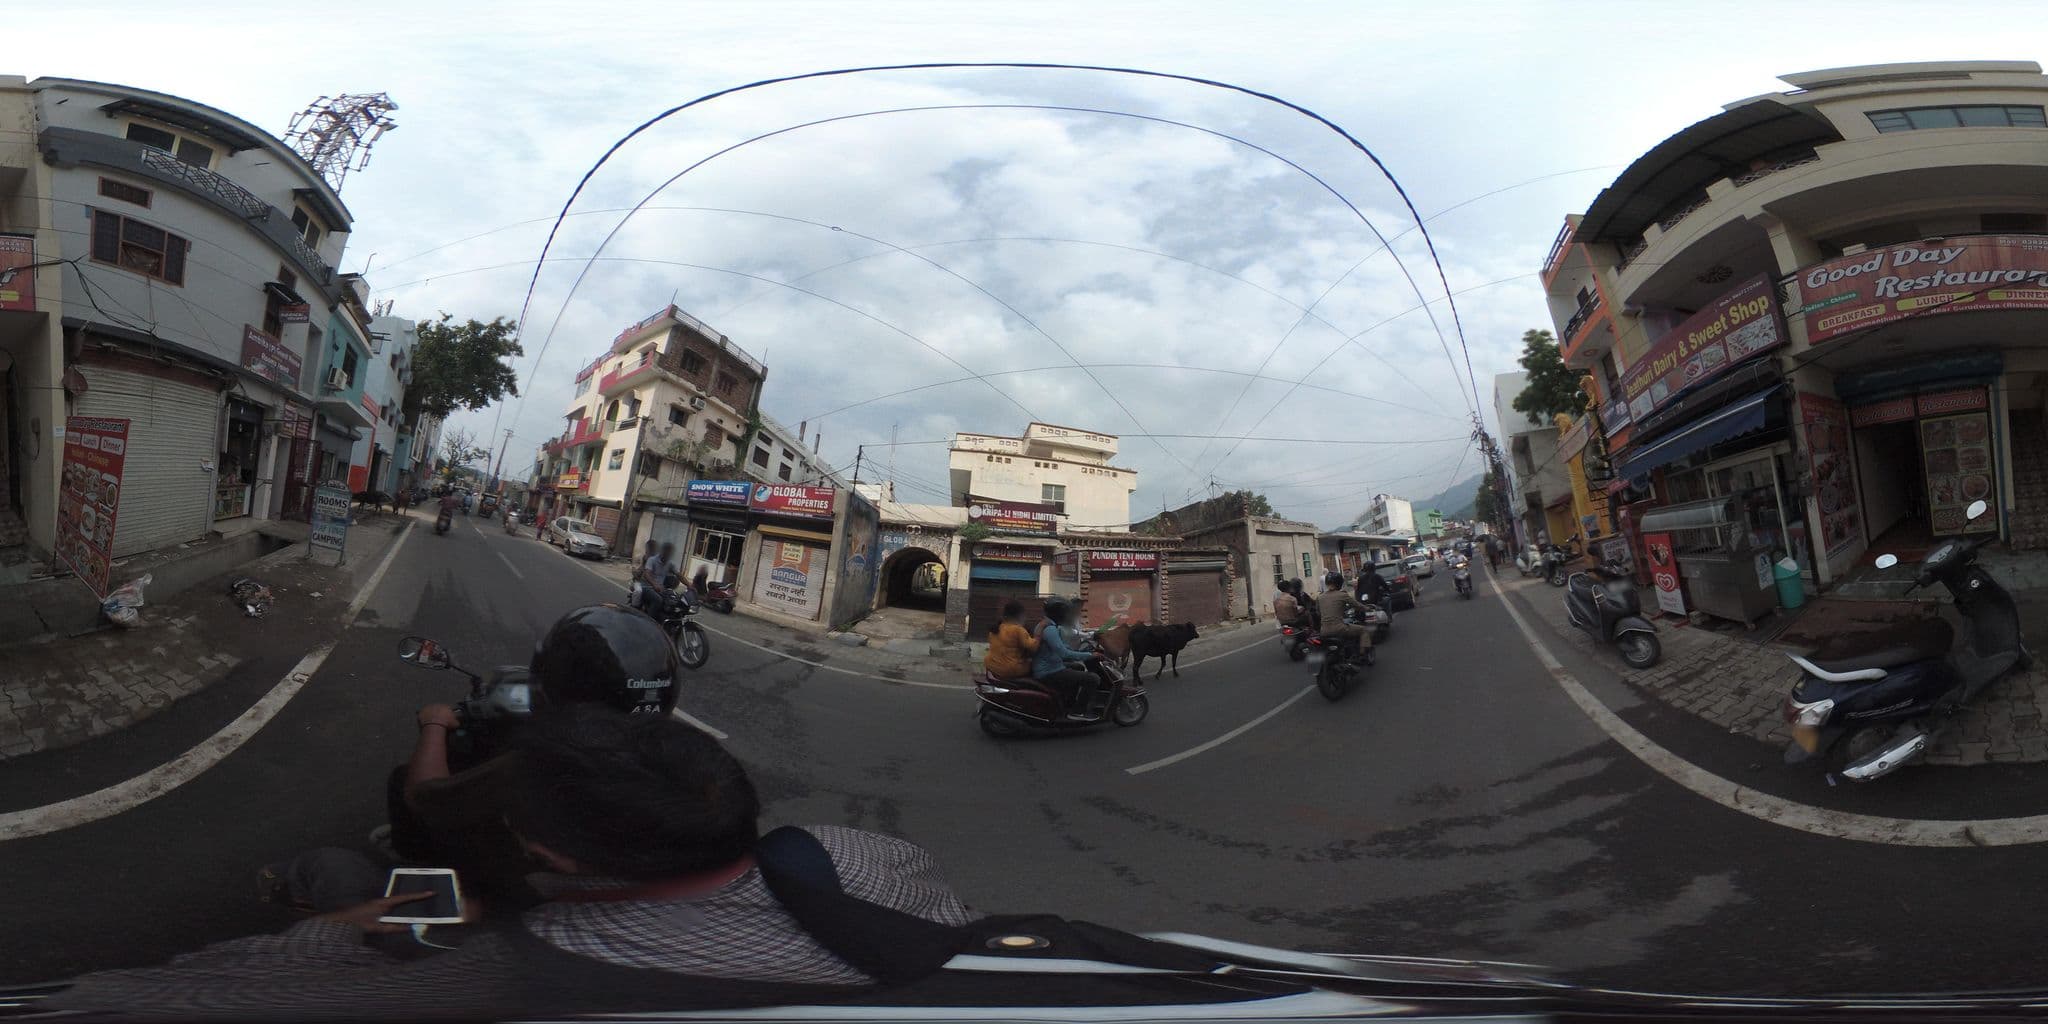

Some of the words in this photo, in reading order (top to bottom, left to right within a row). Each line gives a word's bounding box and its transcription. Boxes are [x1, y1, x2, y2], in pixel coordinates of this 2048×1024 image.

[1806, 253, 1885, 289] Good
[1892, 245, 1967, 266] Day
[1916, 295, 1954, 306] LUNCH
[1822, 307, 1881, 329] BREAKFAST
[1653, 351, 1677, 377] Dairy
[1679, 341, 1688, 357] &
[1688, 314, 1729, 350] Sweet
[1728, 295, 1770, 325] Shop
[715, 485, 744, 493] WHITE
[773, 486, 807, 498] GLOBAL
[318, 495, 348, 509] ROOMS
[788, 498, 829, 509] PROPERTIES
[1119, 552, 1133, 560] TENT
[1135, 552, 1155, 560] HOUSE
